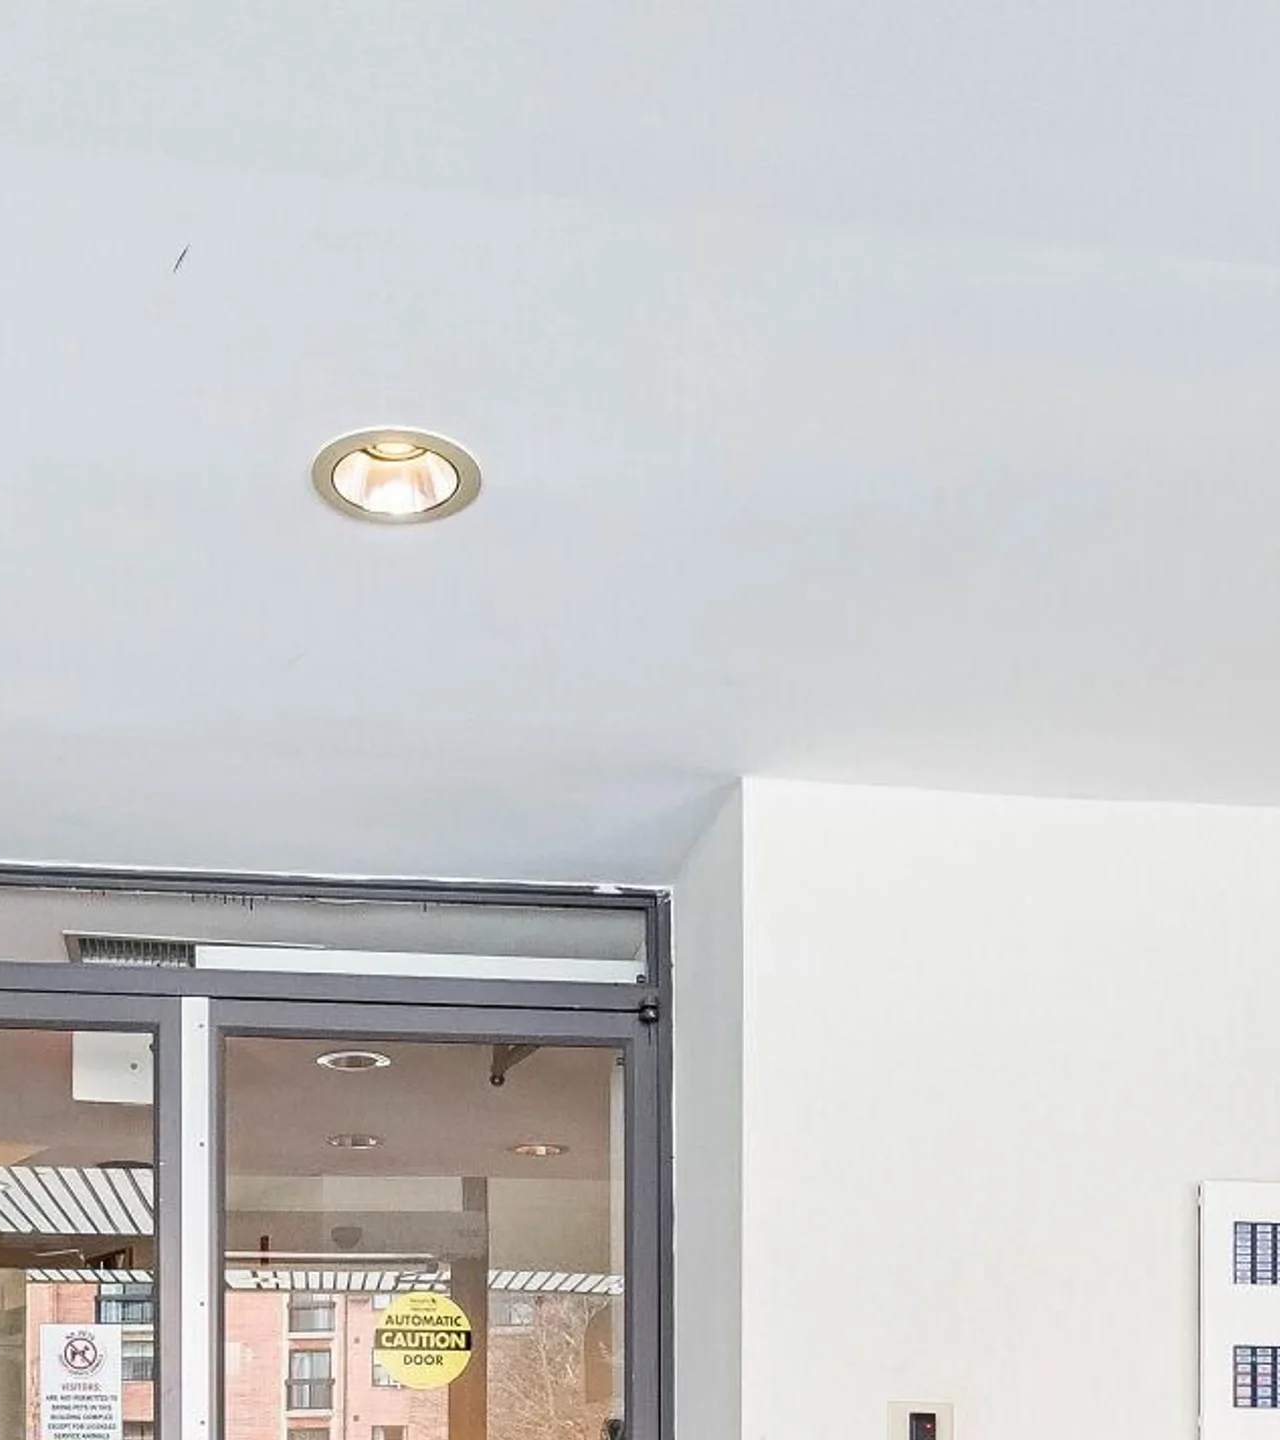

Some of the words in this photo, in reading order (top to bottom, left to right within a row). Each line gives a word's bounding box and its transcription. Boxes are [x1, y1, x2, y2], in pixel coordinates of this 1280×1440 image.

[385, 1314, 462, 1327] AUTOMATIC
[381, 1331, 466, 1349] CAUTION
[403, 1354, 444, 1365] DOOR
